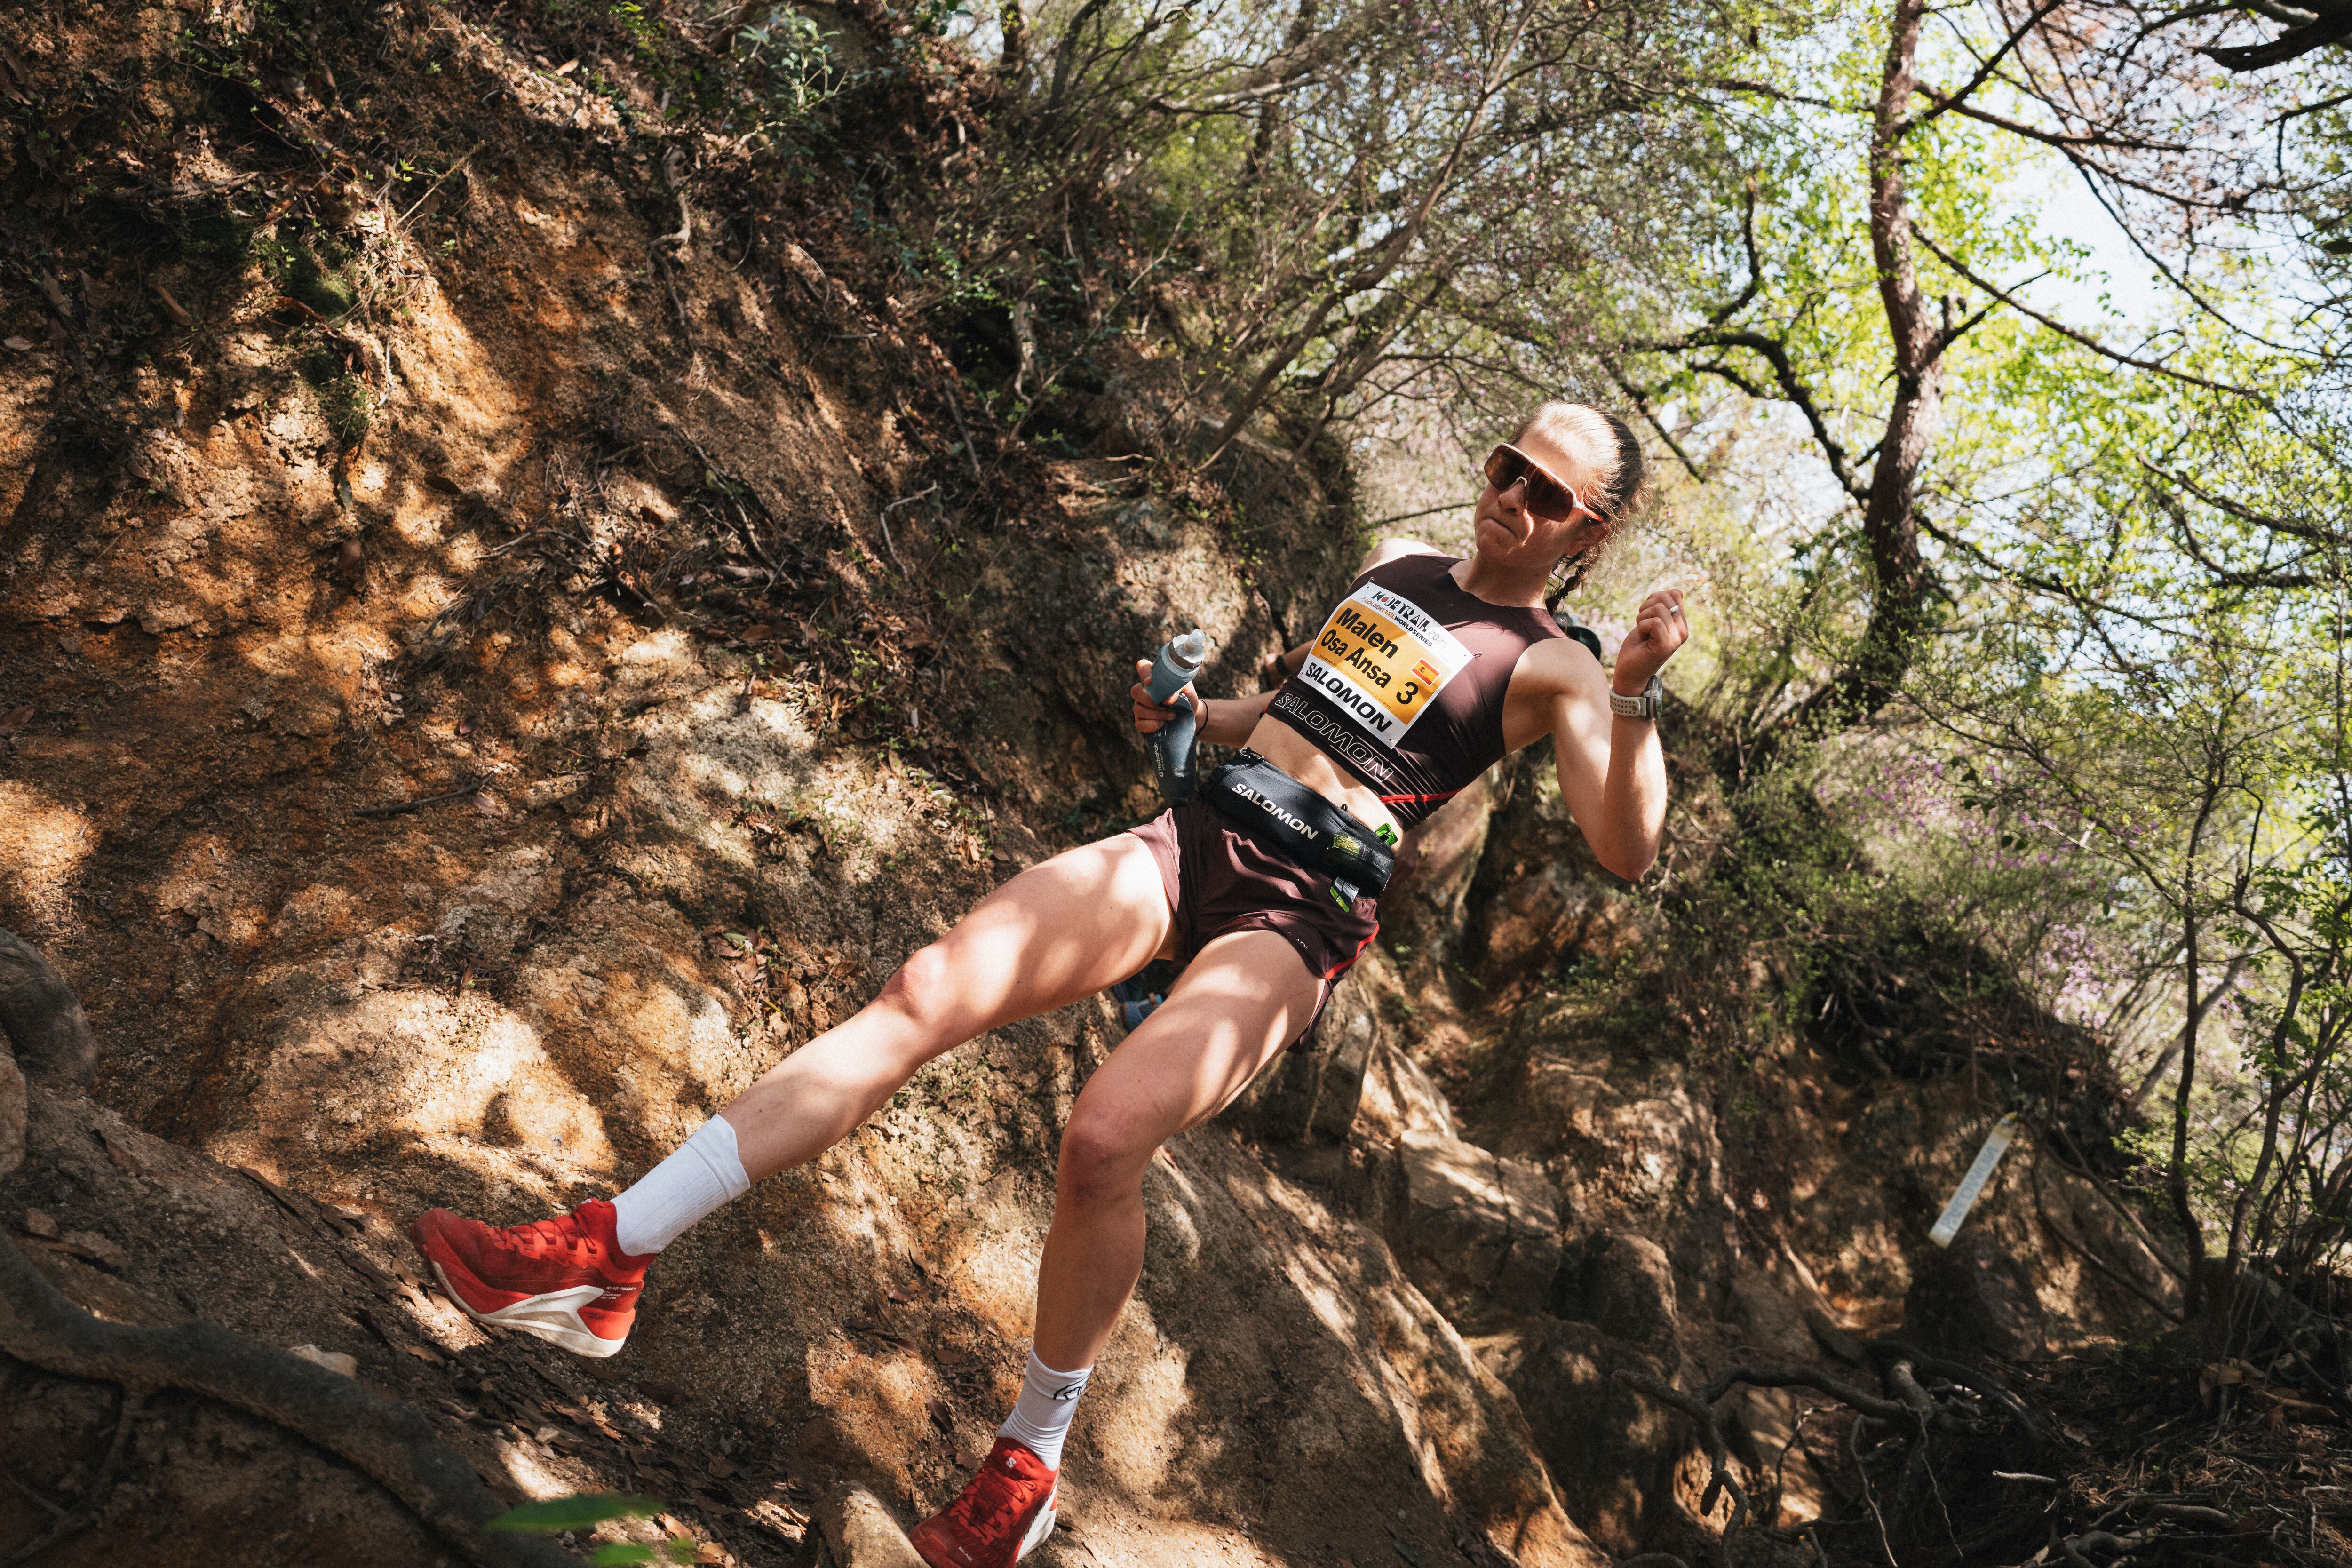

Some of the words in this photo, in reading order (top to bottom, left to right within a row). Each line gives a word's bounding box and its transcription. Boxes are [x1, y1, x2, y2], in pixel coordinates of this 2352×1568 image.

[1335, 607, 1398, 659] Malen
[1398, 603, 1430, 633] TRAIL
[1321, 629, 1349, 657] Osa
[1344, 647, 1391, 689] Ansa
[1305, 662, 1393, 733] SALOMON
[1396, 681, 1419, 705] 3
[1275, 693, 1394, 783] SALOMON
[1232, 783, 1319, 840] SALOMON
